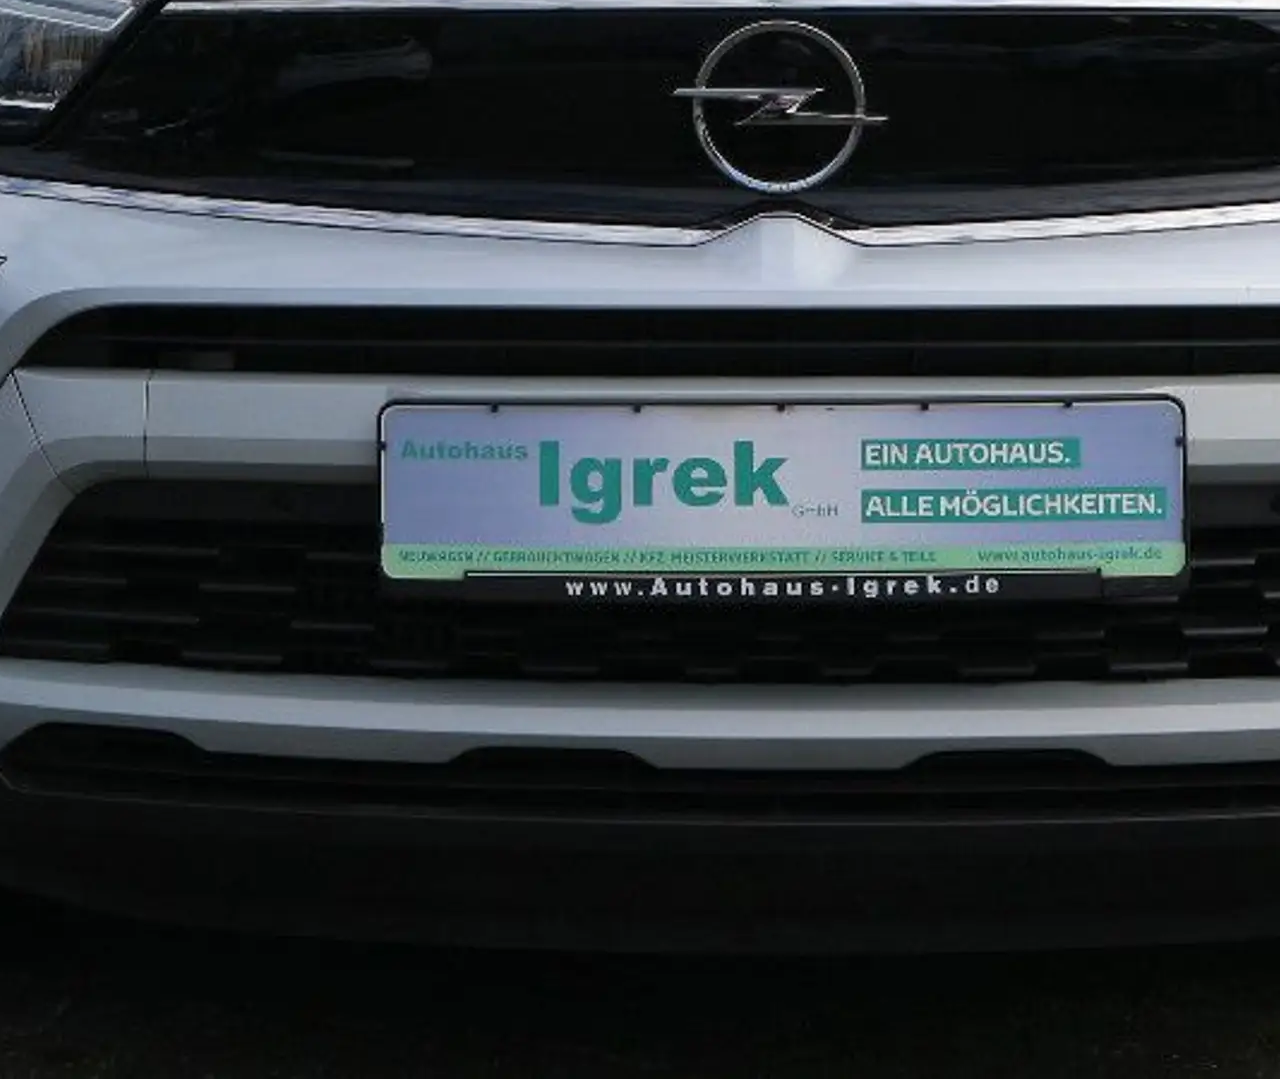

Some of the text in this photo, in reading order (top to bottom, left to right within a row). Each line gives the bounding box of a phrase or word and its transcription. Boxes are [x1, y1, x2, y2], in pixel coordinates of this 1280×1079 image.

[865, 441, 1071, 464] EIN AUTOHAUS.
[401, 440, 528, 460] Autohaus
[539, 440, 789, 524] Igrek
[866, 490, 1163, 517] ALLE MÖGLICHKEITEN.
[565, 576, 1000, 599] www.Autohaus-Igrek.de
